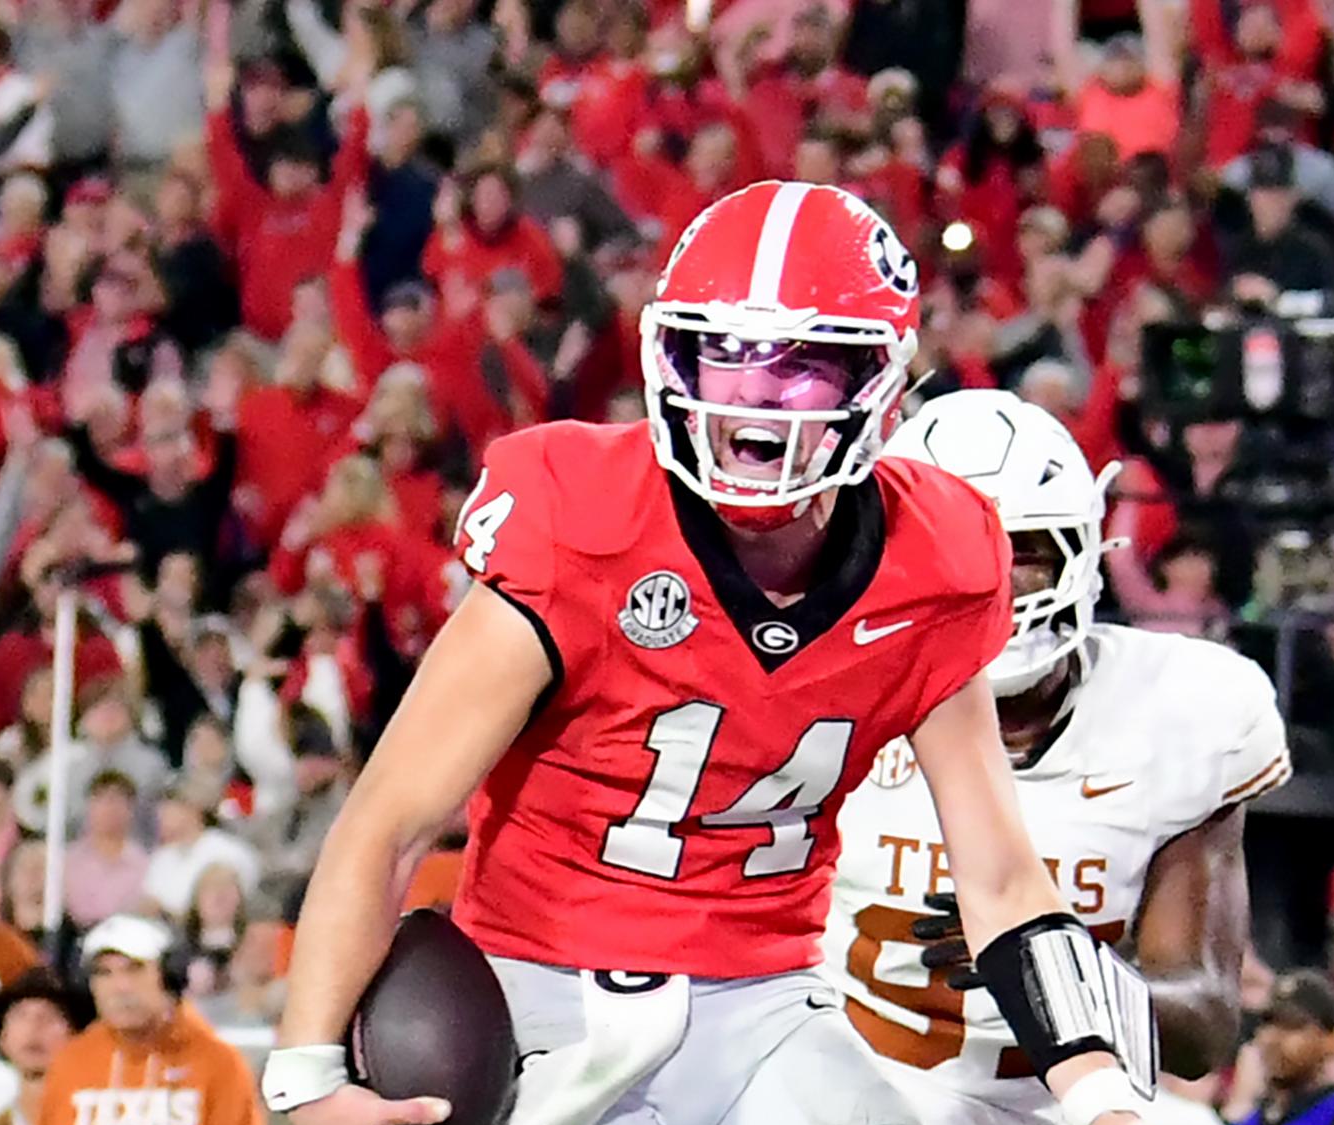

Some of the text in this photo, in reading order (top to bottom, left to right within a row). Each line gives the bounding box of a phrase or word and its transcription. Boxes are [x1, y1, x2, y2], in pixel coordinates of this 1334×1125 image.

[631, 576, 686, 630] SEC
[752, 621, 799, 655] G
[599, 698, 855, 881] 14
[877, 834, 1107, 915] TES
